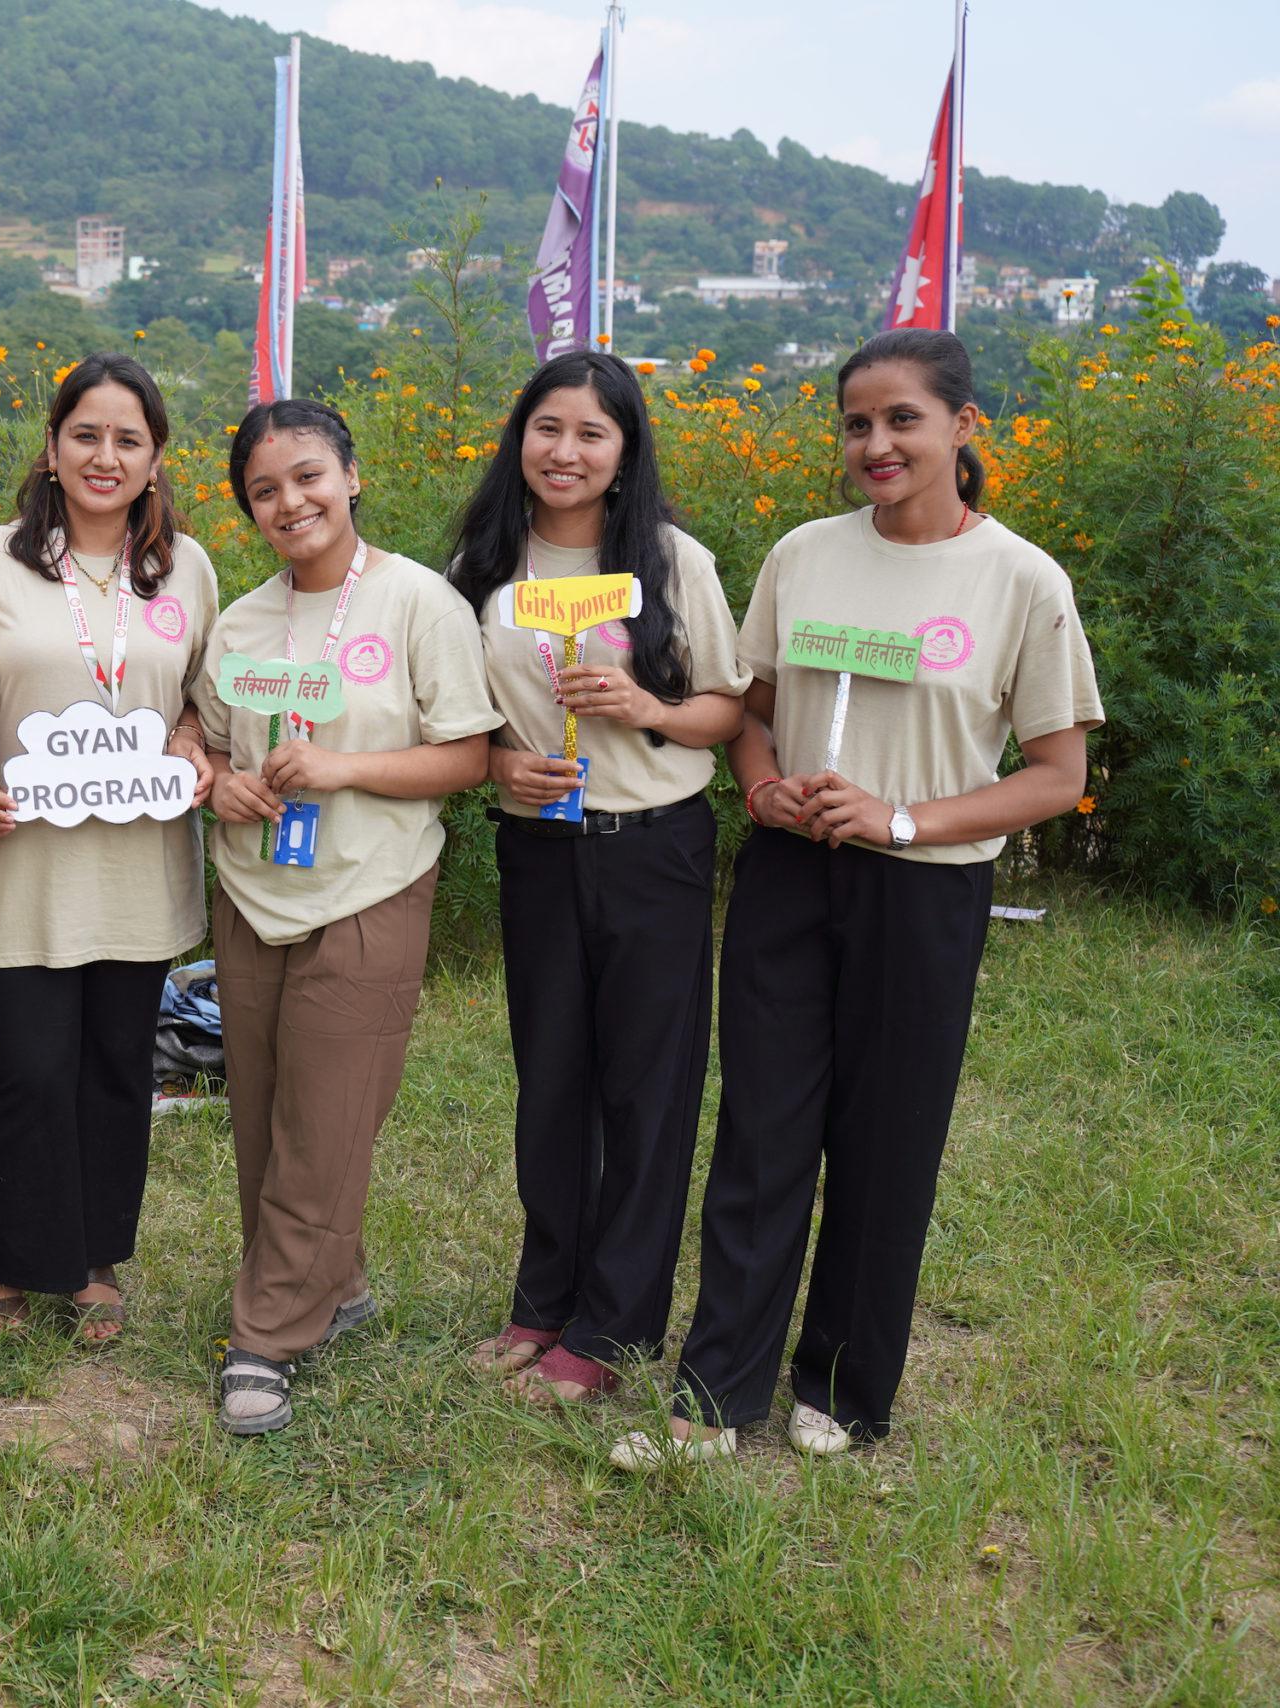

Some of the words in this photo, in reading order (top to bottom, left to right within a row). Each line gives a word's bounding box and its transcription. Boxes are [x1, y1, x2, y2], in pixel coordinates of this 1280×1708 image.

[517, 583, 565, 622] Girls
[570, 587, 626, 633] power
[297, 672, 330, 701] दिदी
[46, 725, 138, 757] GYAN
[11, 775, 182, 811] PROGRAM
